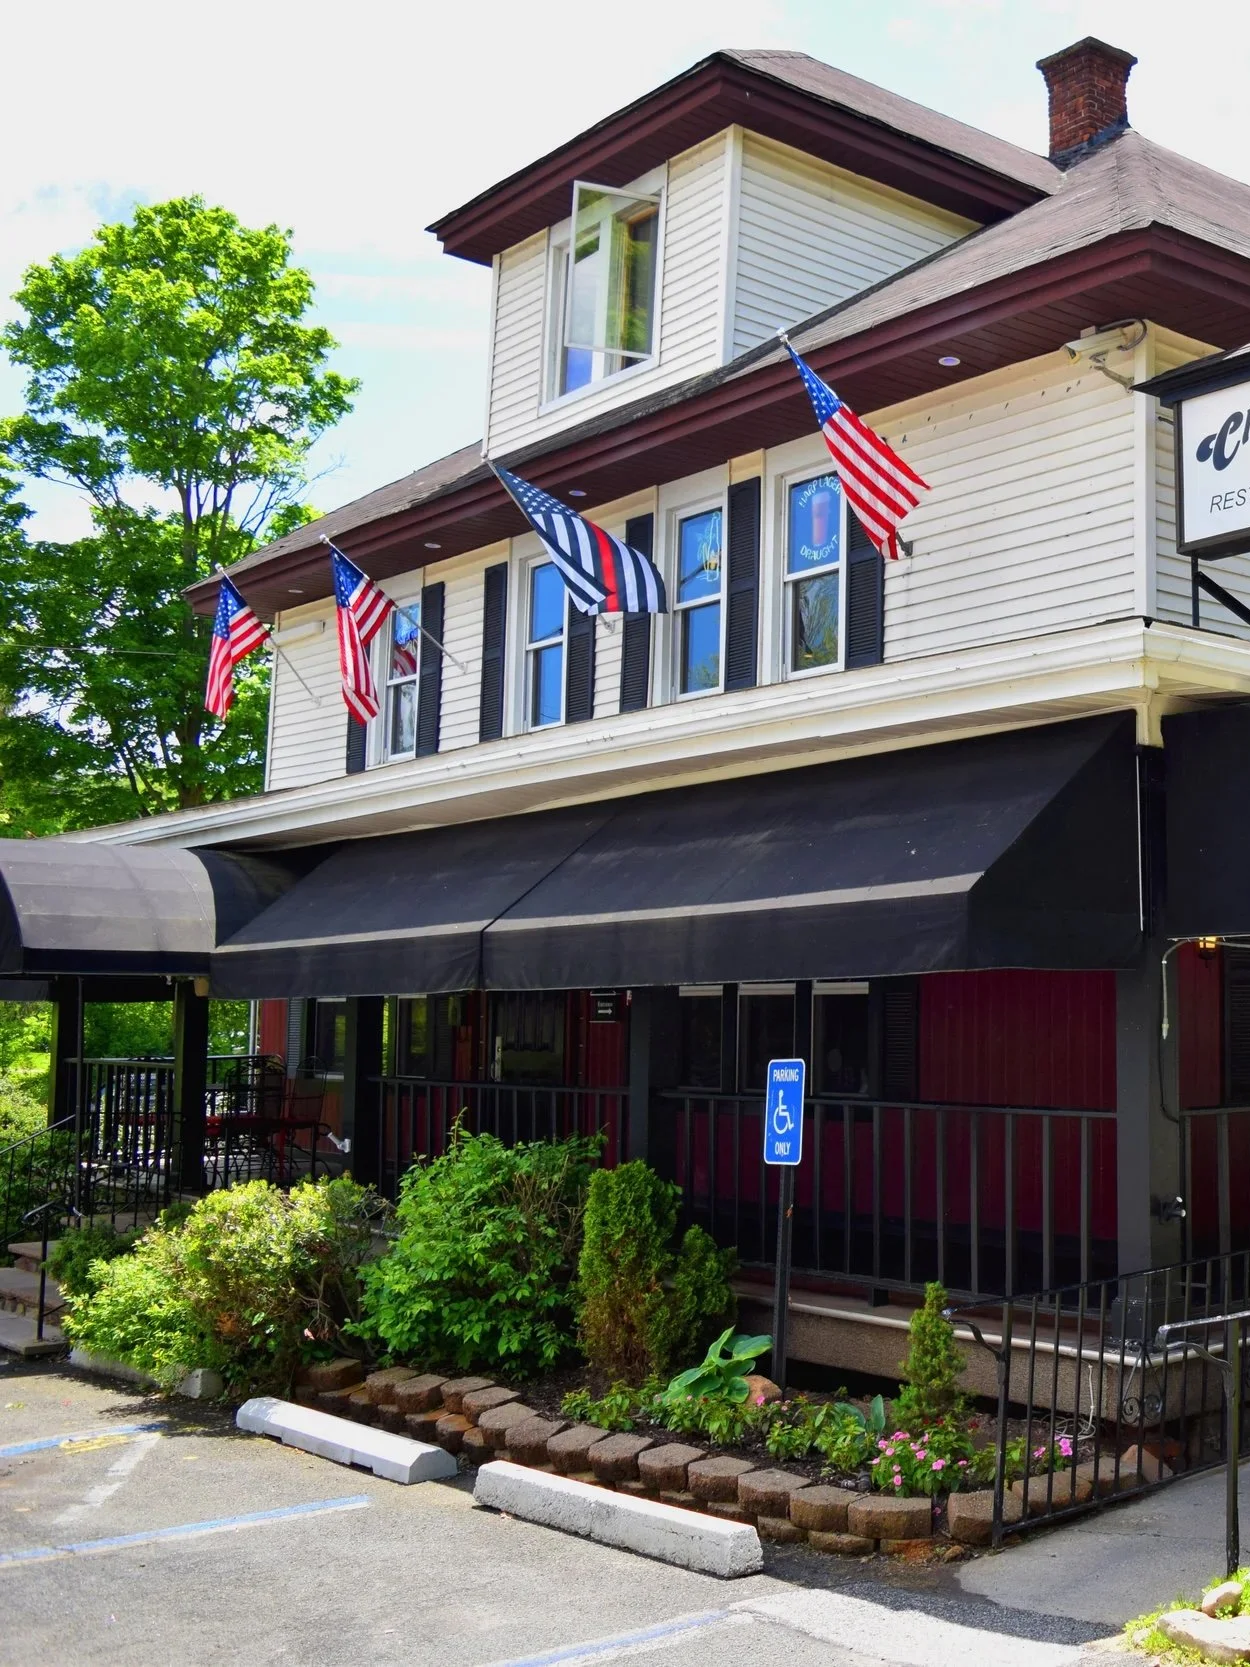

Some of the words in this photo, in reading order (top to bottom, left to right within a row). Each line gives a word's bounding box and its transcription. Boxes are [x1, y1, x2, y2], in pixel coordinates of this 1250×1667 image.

[799, 480, 817, 507] HARP
[800, 535, 838, 560] DRAUGHT
[773, 1068, 799, 1082] PARKING
[774, 1142, 791, 1156] ONLY
